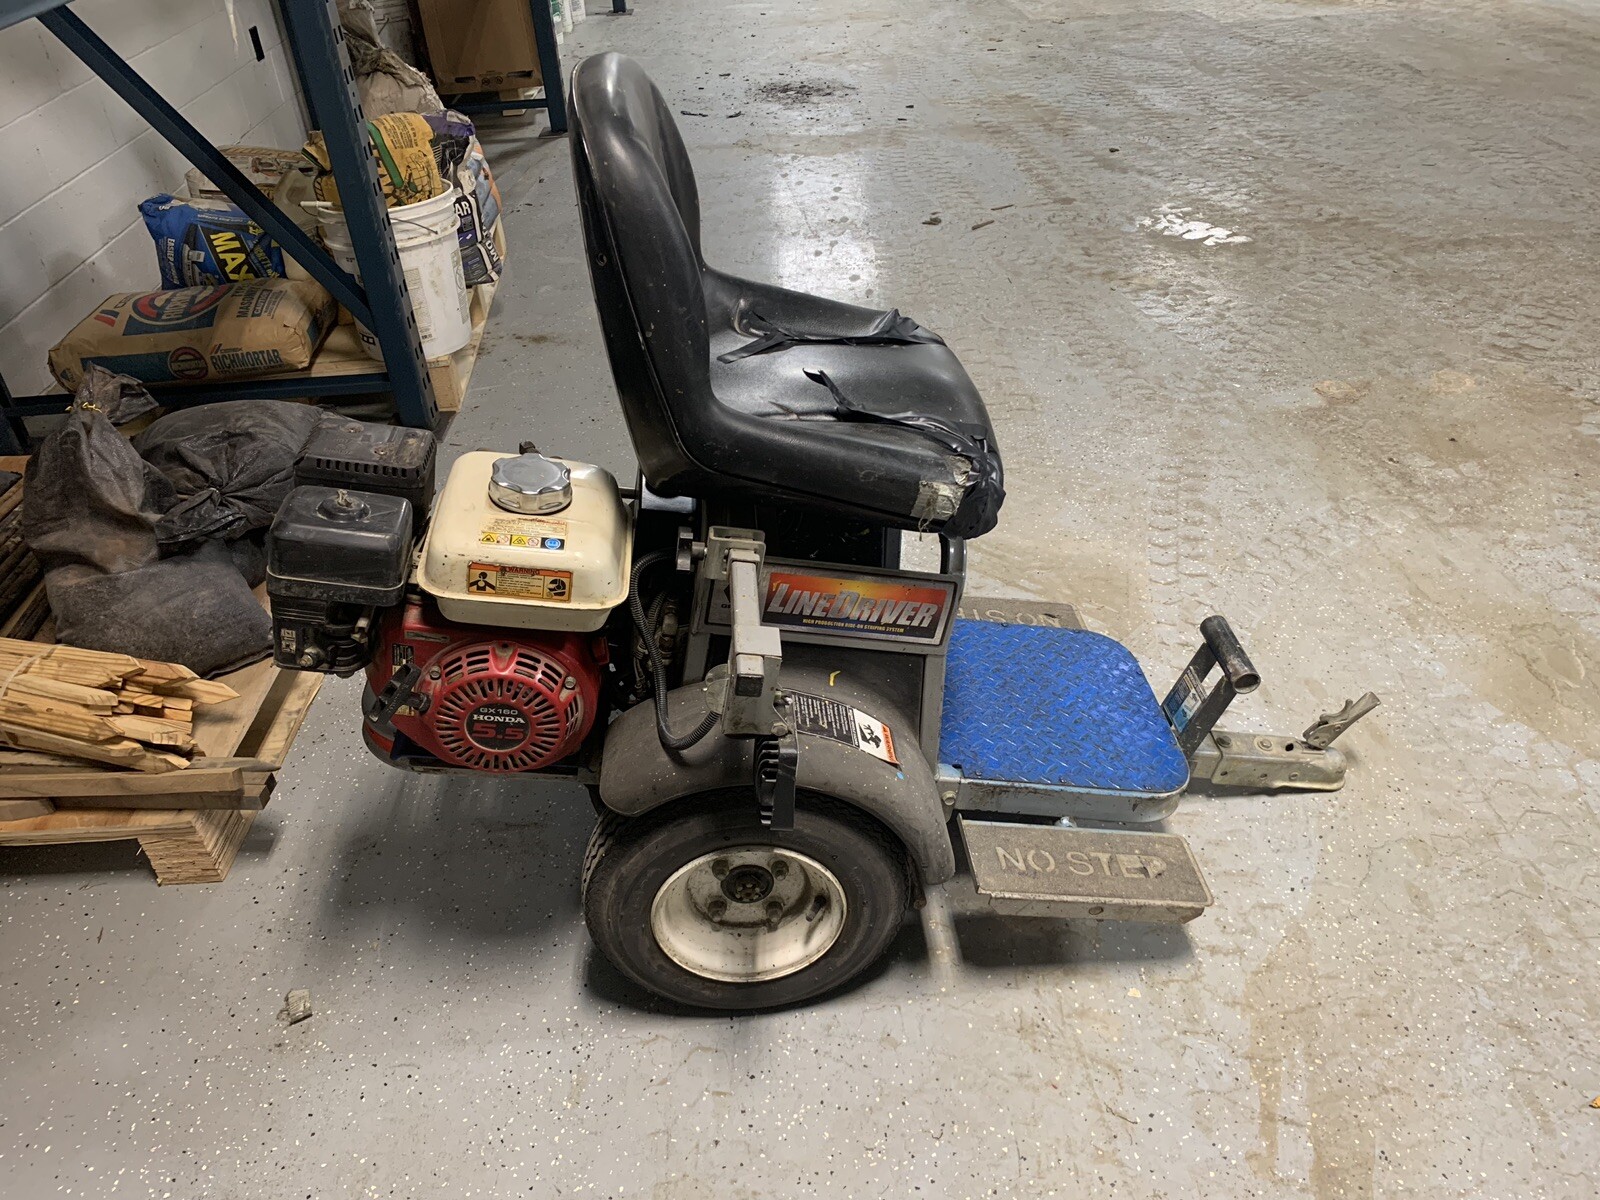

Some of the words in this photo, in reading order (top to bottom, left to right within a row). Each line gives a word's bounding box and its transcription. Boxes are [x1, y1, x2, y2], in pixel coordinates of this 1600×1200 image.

[210, 348, 283, 370] RICHMORTAR
[473, 714, 526, 724] HONDA
[479, 707, 519, 715] GX160
[471, 722, 525, 740] 5.5
[995, 846, 1055, 873] NO
[1066, 851, 1168, 880] STEP
